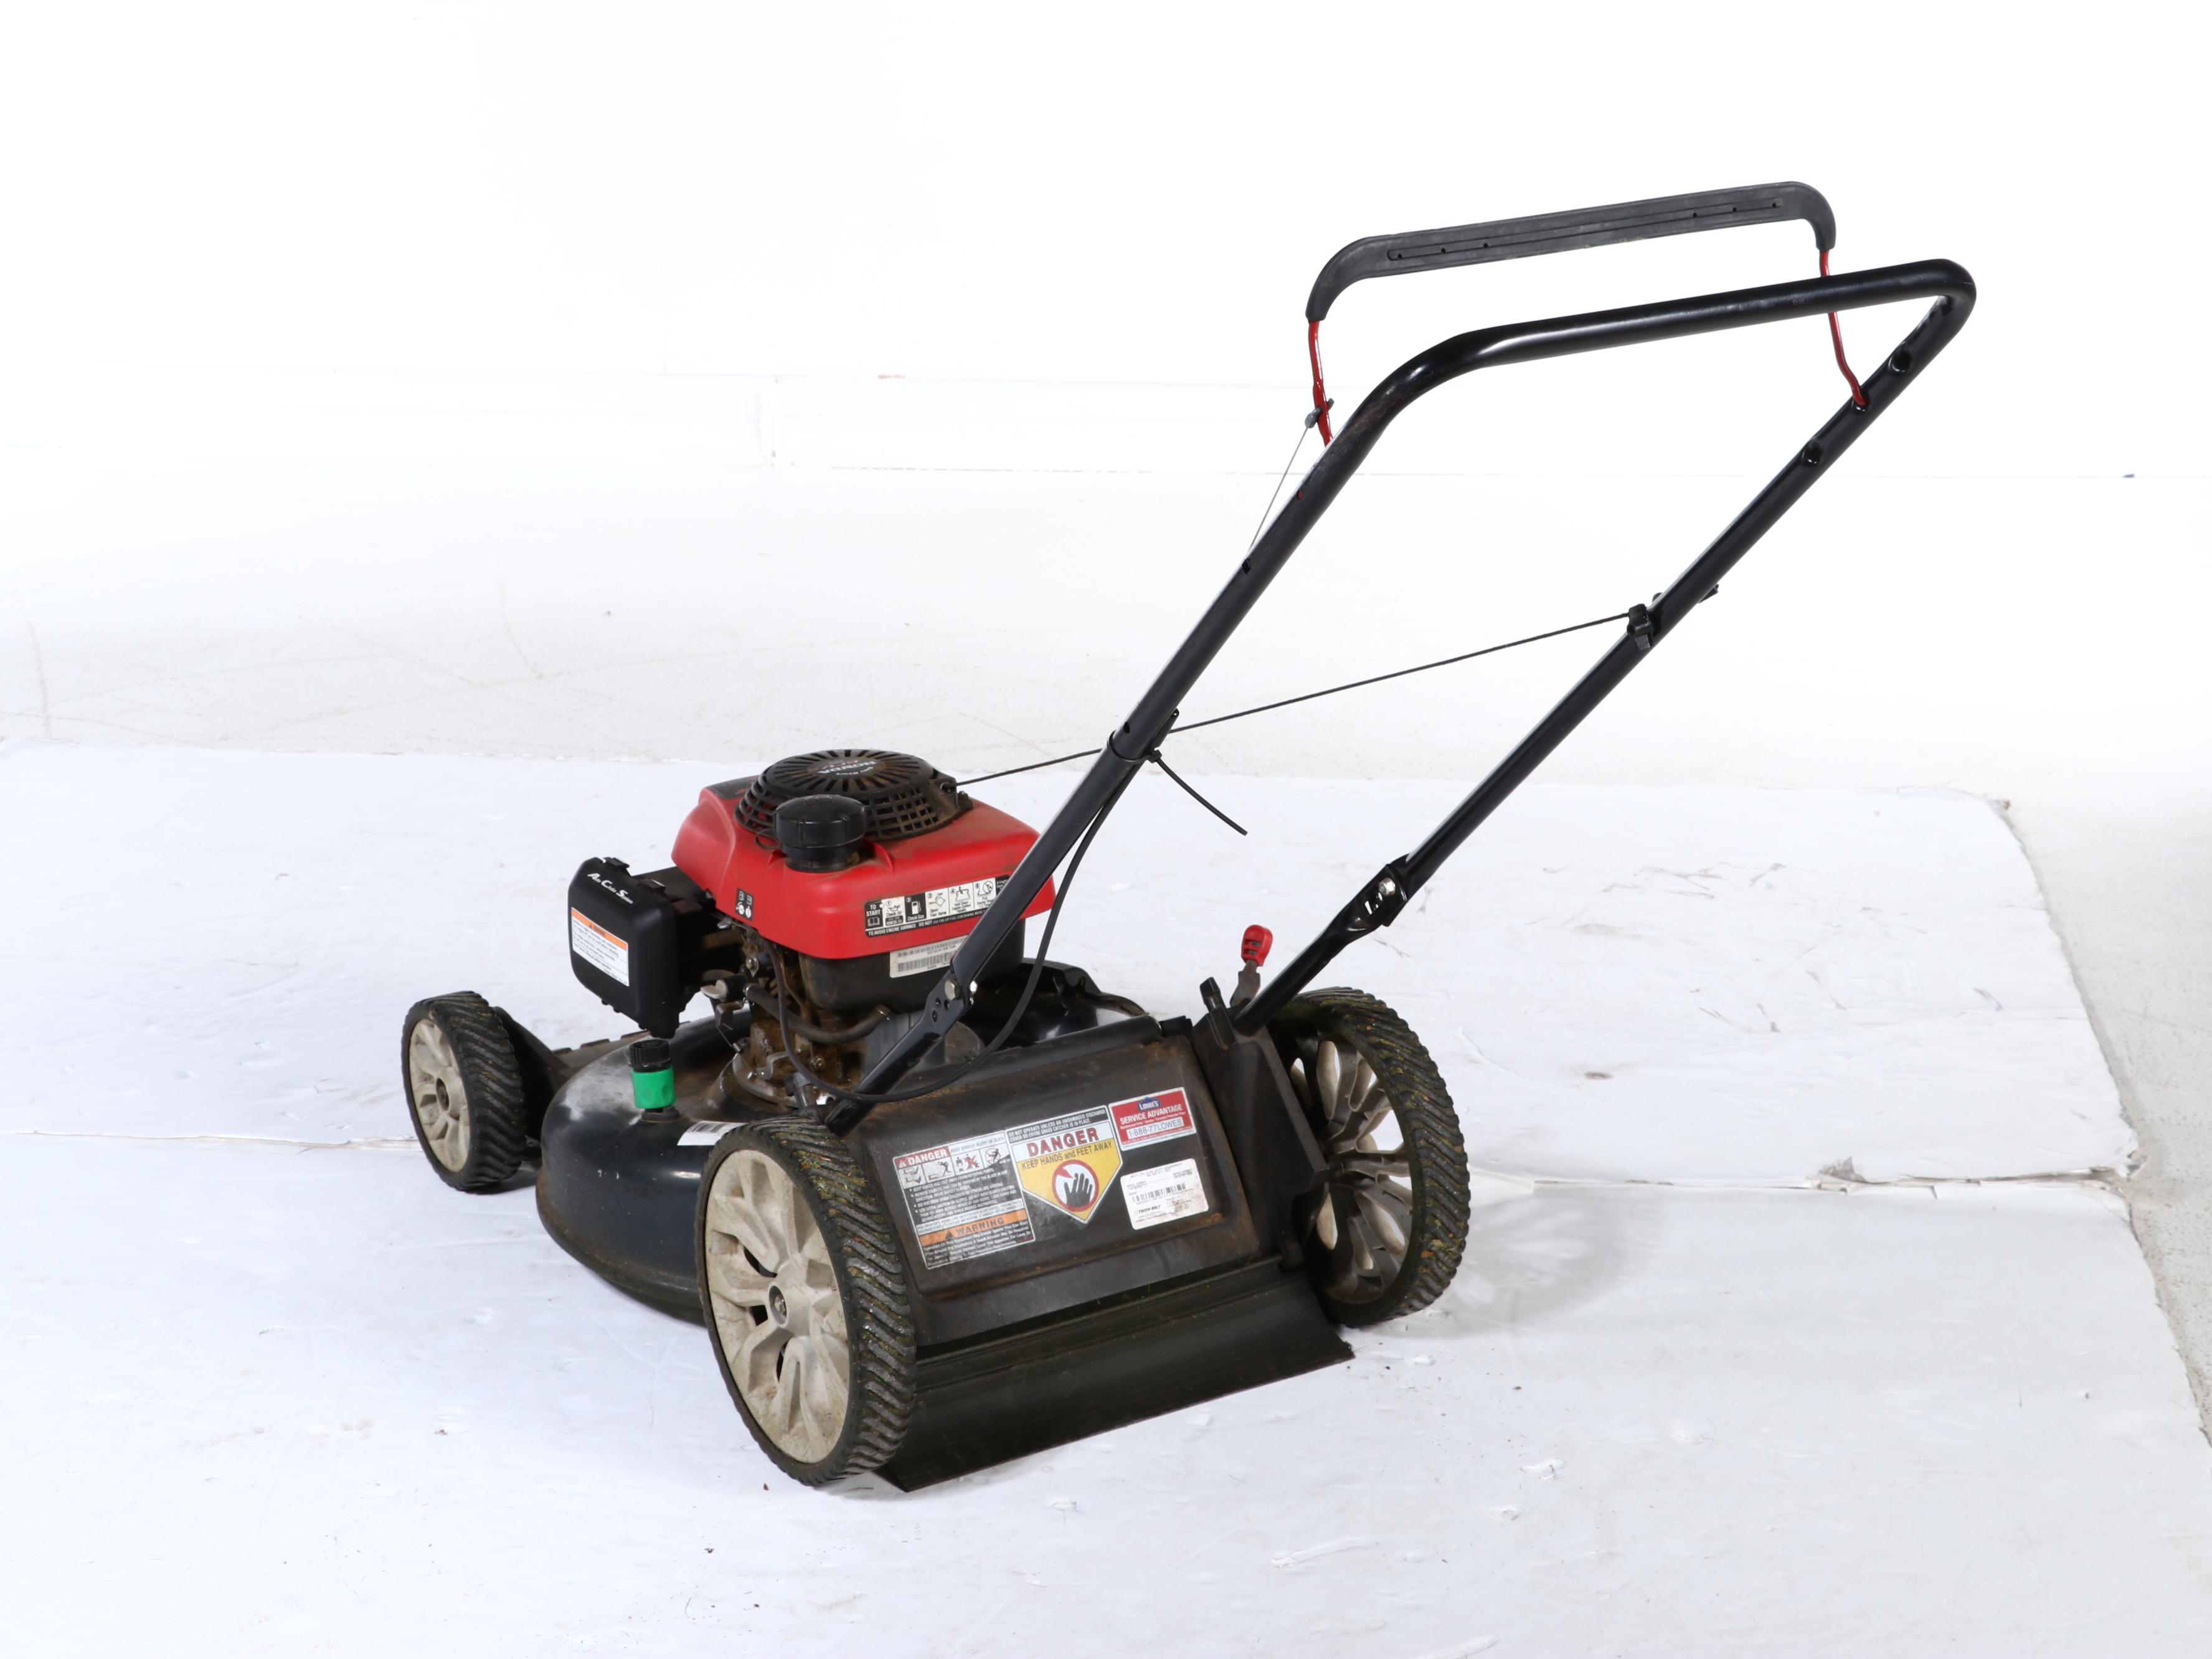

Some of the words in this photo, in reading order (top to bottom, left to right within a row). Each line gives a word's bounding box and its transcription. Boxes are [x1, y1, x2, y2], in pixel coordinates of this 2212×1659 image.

[817, 761, 877, 773] HONDA
[1120, 1113, 1146, 1125] SERVICE
[1148, 1104, 1183, 1118] ADVANTAGE
[1128, 1118, 1182, 1138] 1-888-77LOWES
[1027, 1127, 1099, 1156] DANGER
[908, 1149, 947, 1165] DANGER
[1021, 1159, 1039, 1170] KEEP
[1040, 1153, 1063, 1165] HANDS
[1064, 1150, 1075, 1160] and
[1076, 1145, 1092, 1156] FEET
[1093, 1140, 1112, 1151] AWAY
[957, 1217, 1004, 1235] WARNING
